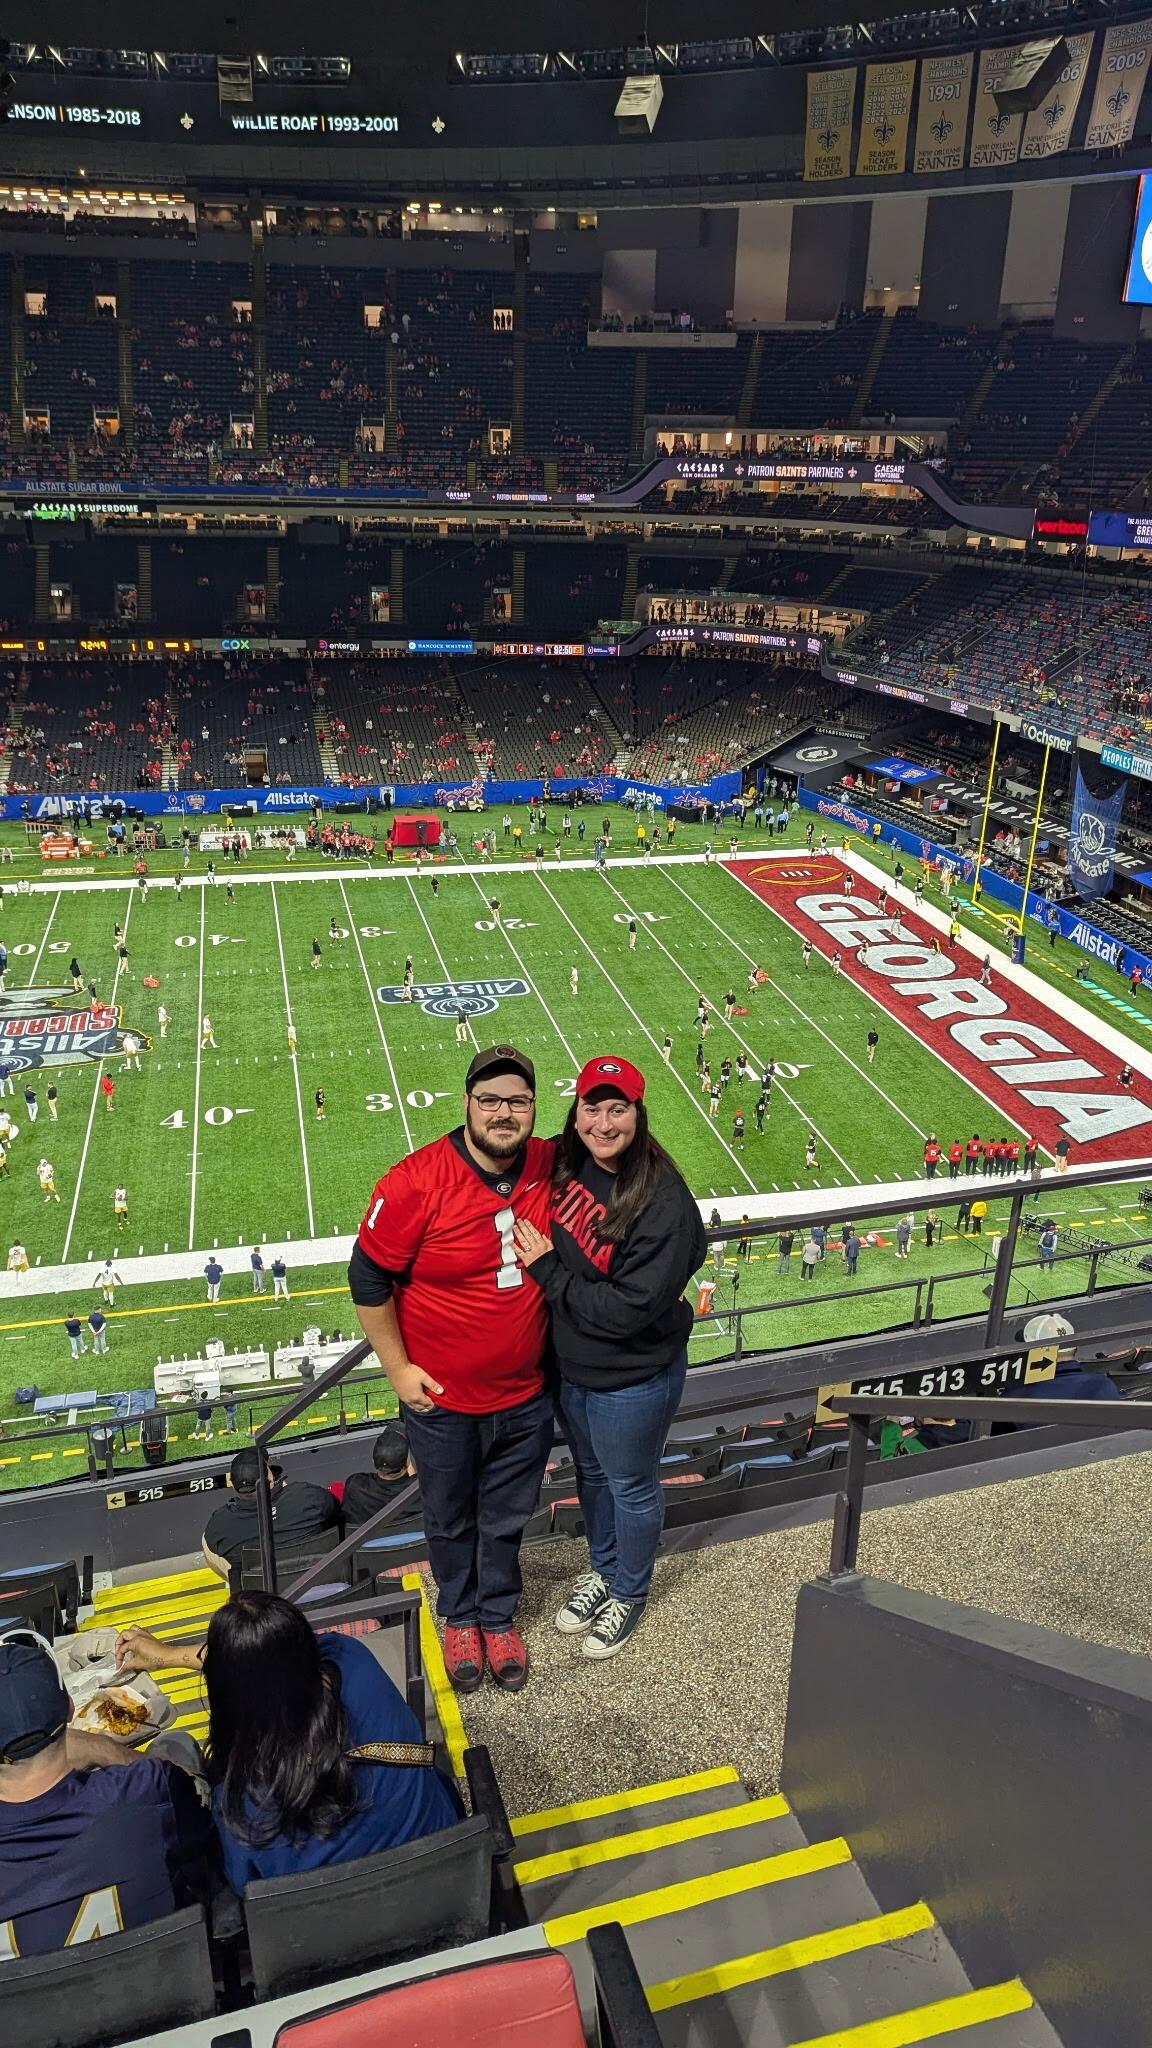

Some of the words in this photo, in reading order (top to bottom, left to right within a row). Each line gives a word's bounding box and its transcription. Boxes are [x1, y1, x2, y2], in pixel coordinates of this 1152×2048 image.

[1066, 37, 1088, 48] OUTH
[1105, 50, 1146, 73] 2009
[929, 82, 961, 102] 1991
[67, 108, 141, 125] 1985-2018
[232, 115, 278, 130] WILLIE
[281, 116, 318, 131] ROAF
[328, 117, 399, 132] 1993-2001
[1087, 125, 1130, 147] SAINTS
[868, 150, 896, 158] SEASON
[1024, 137, 1065, 156] SAINTS
[917, 155, 960, 170] SAINTS
[973, 150, 1016, 165] SAINTS
[809, 169, 843, 178] HOLDERS
[864, 164, 898, 172] HOLDERS
[677, 463, 725, 472] CAESARS
[748, 465, 775, 477] PATRON
[776, 465, 807, 477] SAINTS
[808, 466, 844, 478] PARTNERS
[874, 464, 905, 473] CAESARS
[26, 481, 66, 492] ALLSTATE
[68, 482, 97, 492] SUGAR
[99, 483, 123, 493] BOWL
[33, 503, 82, 513] CAESARS
[84, 504, 139, 513] SUPERDOME
[1037, 520, 1088, 535] verizon
[656, 628, 695, 637] CAESARS
[712, 631, 734, 642] PATRON
[735, 633, 759, 644] SAINTS
[760, 634, 787, 646] PARTNERS
[80, 641, 107, 650] 92:49
[222, 640, 250, 649] COX
[329, 643, 360, 651] entergy
[837, 672, 858, 682] CAESARS
[1027, 726, 1072, 751] Ochsner
[1102, 749, 1132, 769] PEOPLES
[625, 786, 662, 806] Allstate
[174, 934, 231, 947] 40
[1067, 923, 1121, 966] Allstat
[12, 941, 72, 956] 50
[795, 894, 1152, 1144] GEORGIA
[365, 1090, 434, 1112] 30
[160, 1106, 234, 1129] 40
[497, 1182, 512, 1194] G
[367, 1197, 385, 1230] 1
[494, 1205, 525, 1290] 1
[857, 1379, 904, 1398] 515
[918, 1368, 966, 1397] 513
[980, 1357, 1024, 1386] 511
[138, 1486, 164, 1503] 515
[189, 1477, 214, 1494] 513
